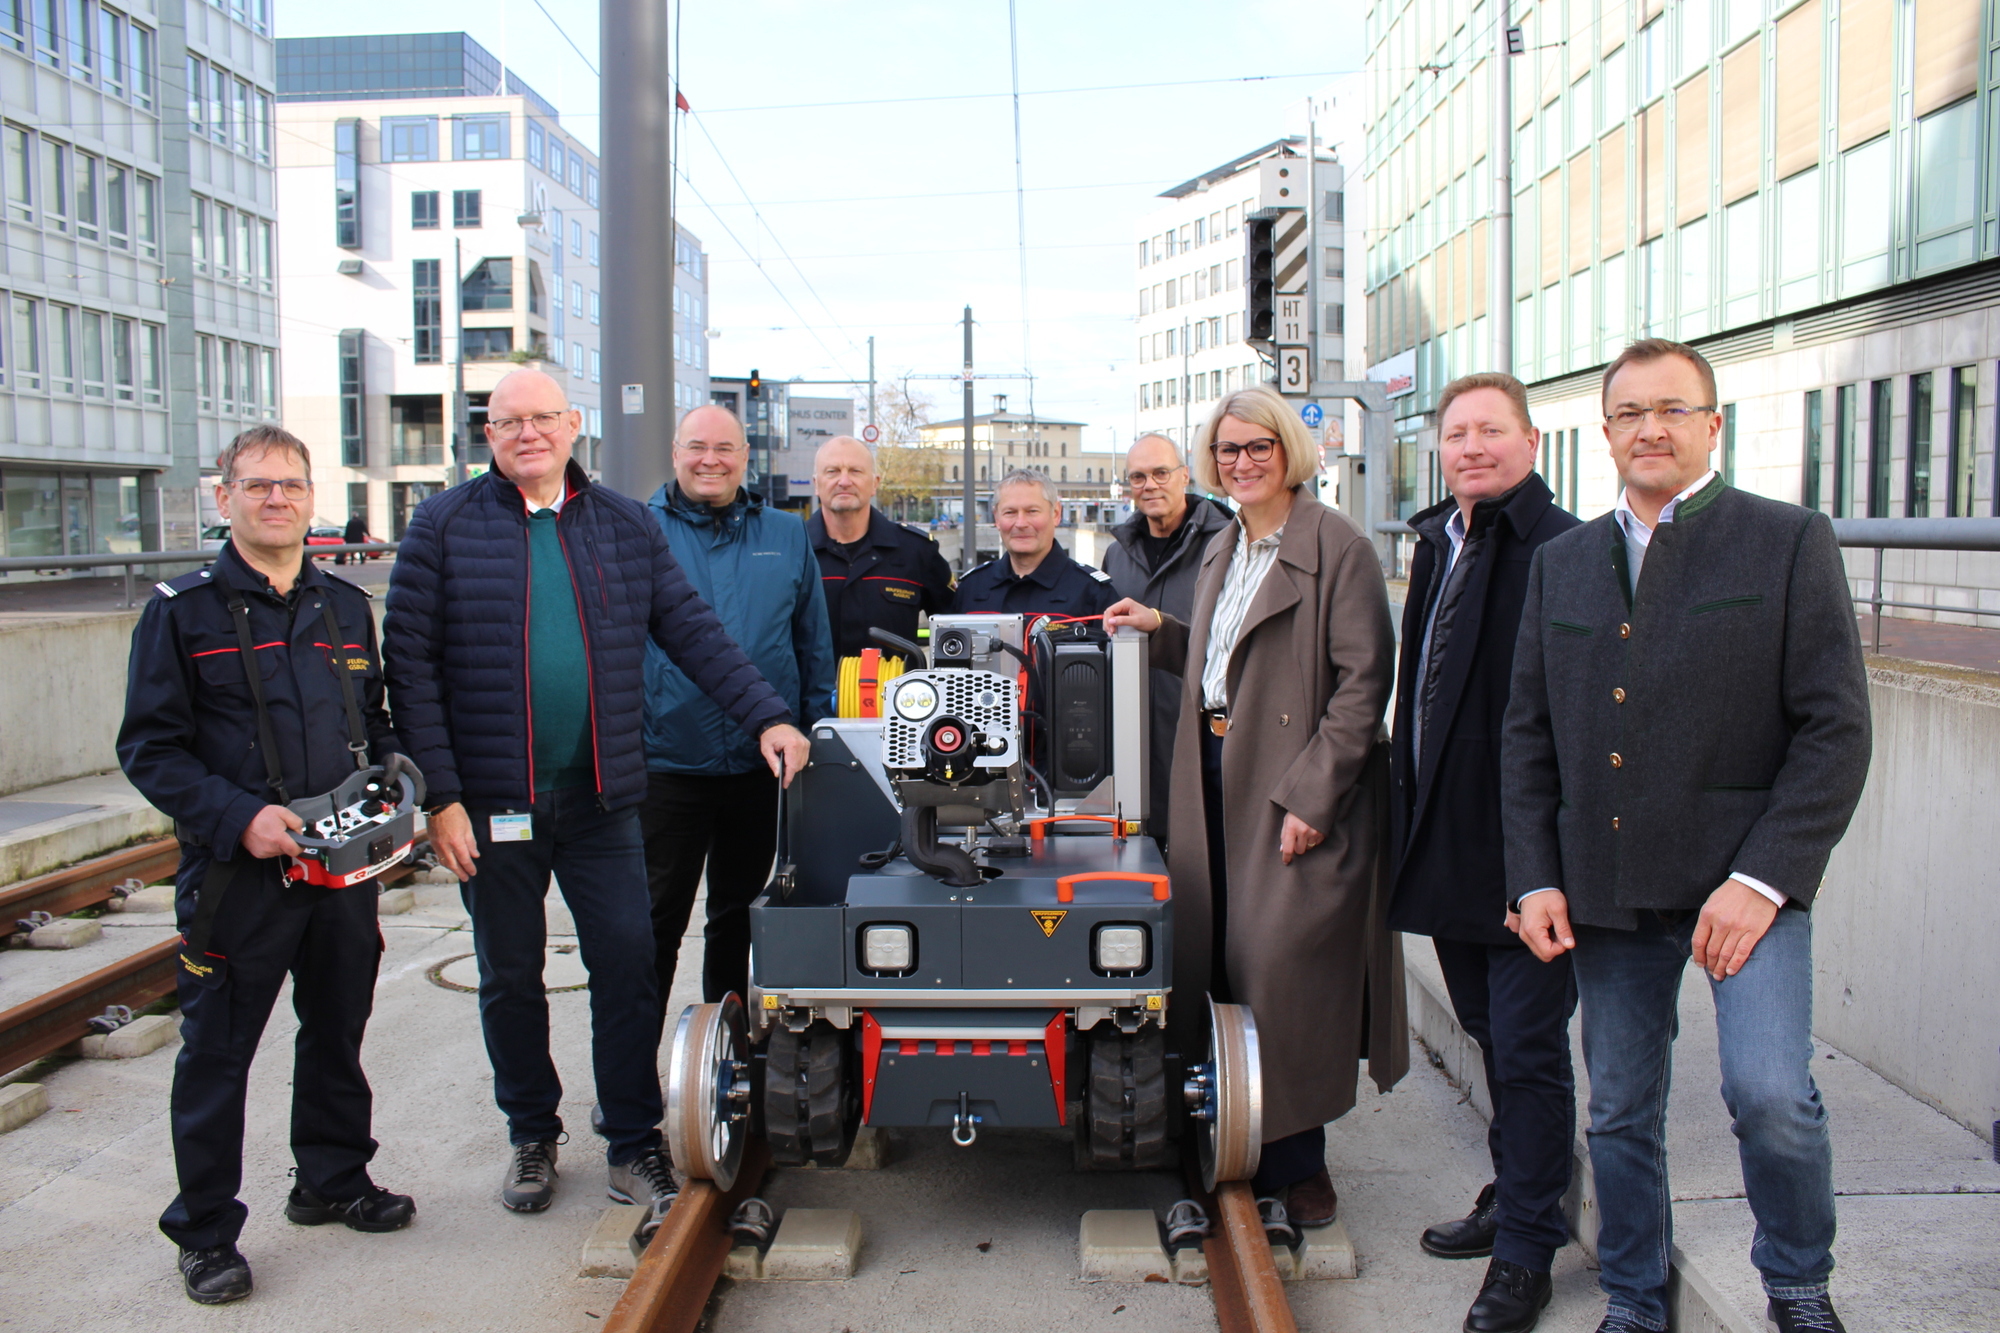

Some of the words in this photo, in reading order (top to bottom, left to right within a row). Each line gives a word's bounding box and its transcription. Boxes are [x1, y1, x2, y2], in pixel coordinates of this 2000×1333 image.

[1506, 28, 1523, 53] E
[1283, 300, 1301, 317] HT
[1285, 322, 1299, 340] 11
[1287, 355, 1301, 387] 3
[813, 410, 848, 420] CENTER
